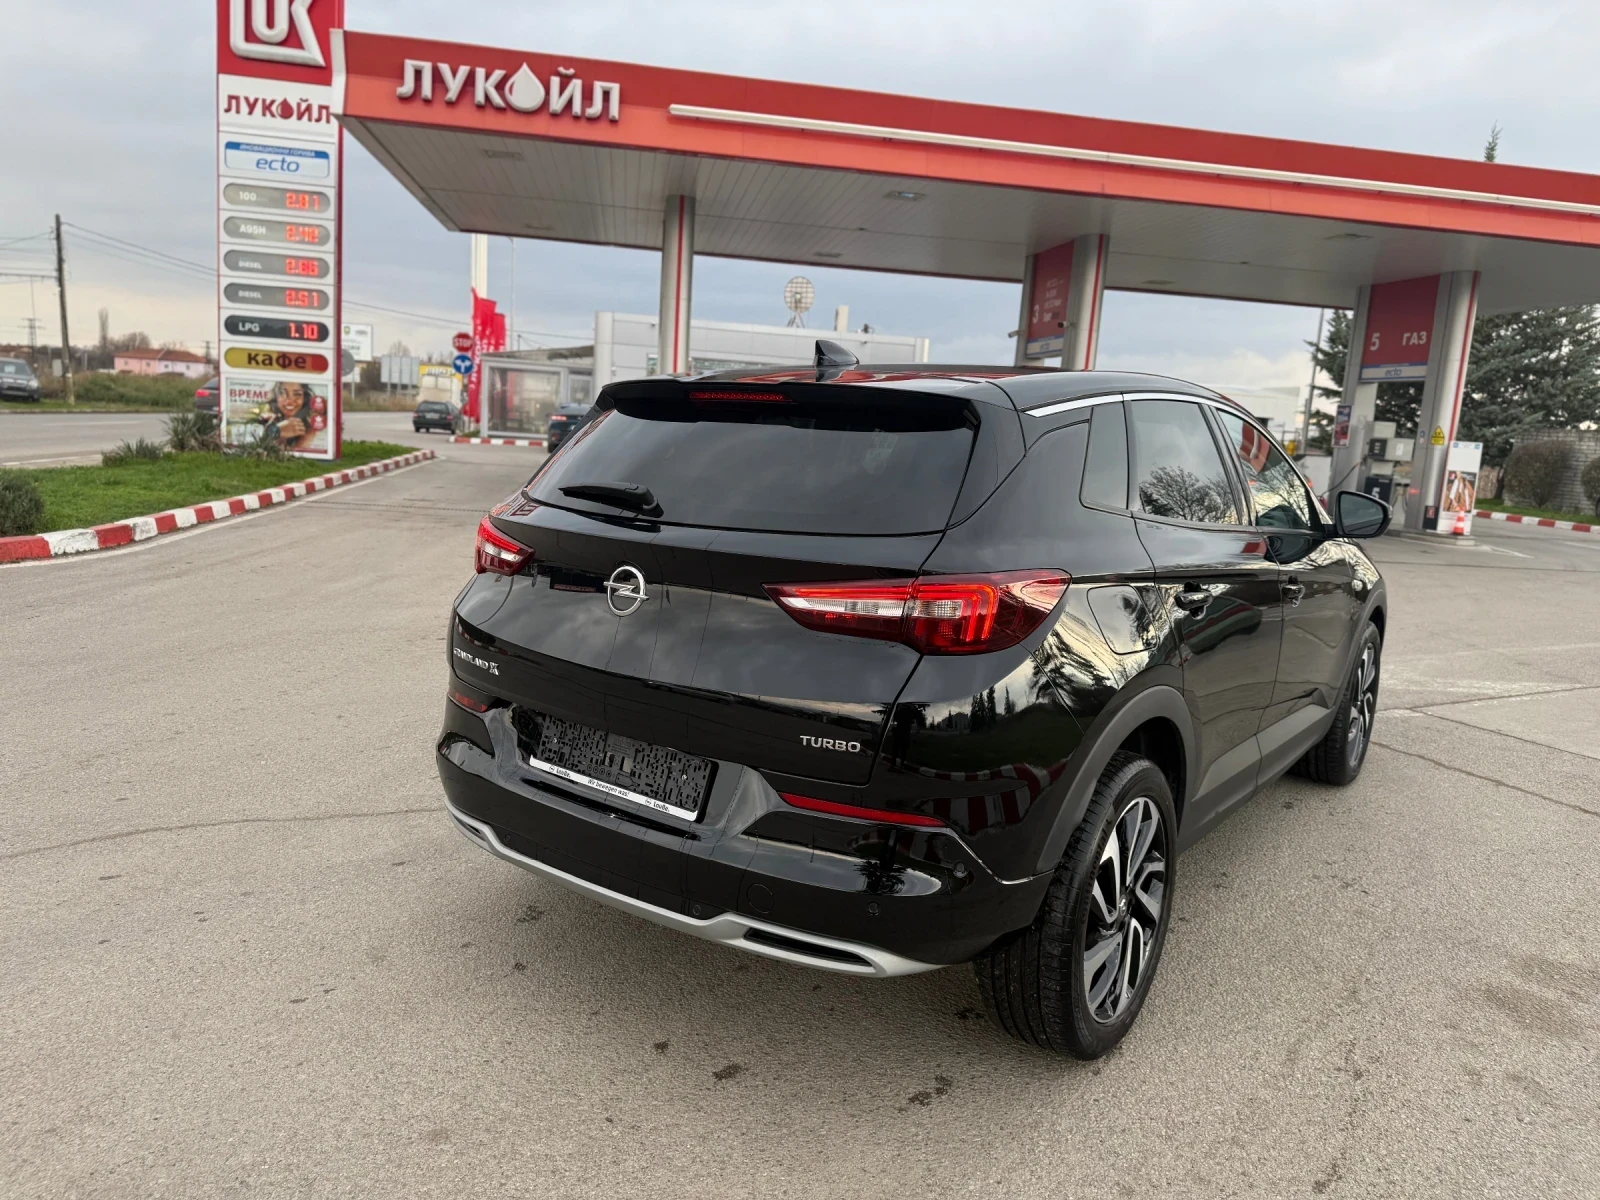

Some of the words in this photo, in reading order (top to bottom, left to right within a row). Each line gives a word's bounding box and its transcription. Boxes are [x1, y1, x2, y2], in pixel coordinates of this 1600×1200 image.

[396, 58, 620, 122] ЛУКОЙЛ
[224, 94, 331, 124] ЛУКОЙЛ
[256, 157, 300, 173] ecto
[239, 191, 257, 201] 100
[1032, 304, 1040, 324] 3
[239, 322, 260, 332] LPG
[288, 322, 319, 340] 1.10
[1402, 331, 1427, 346] ГАЗ
[454, 338, 472, 348] STOP
[1370, 332, 1380, 351] 5
[247, 352, 307, 369] кафе
[229, 388, 270, 399] ВРЕМЕ
[800, 735, 861, 753] TURBO
[587, 778, 596, 786] Wir
[595, 780, 618, 794] bewegen
